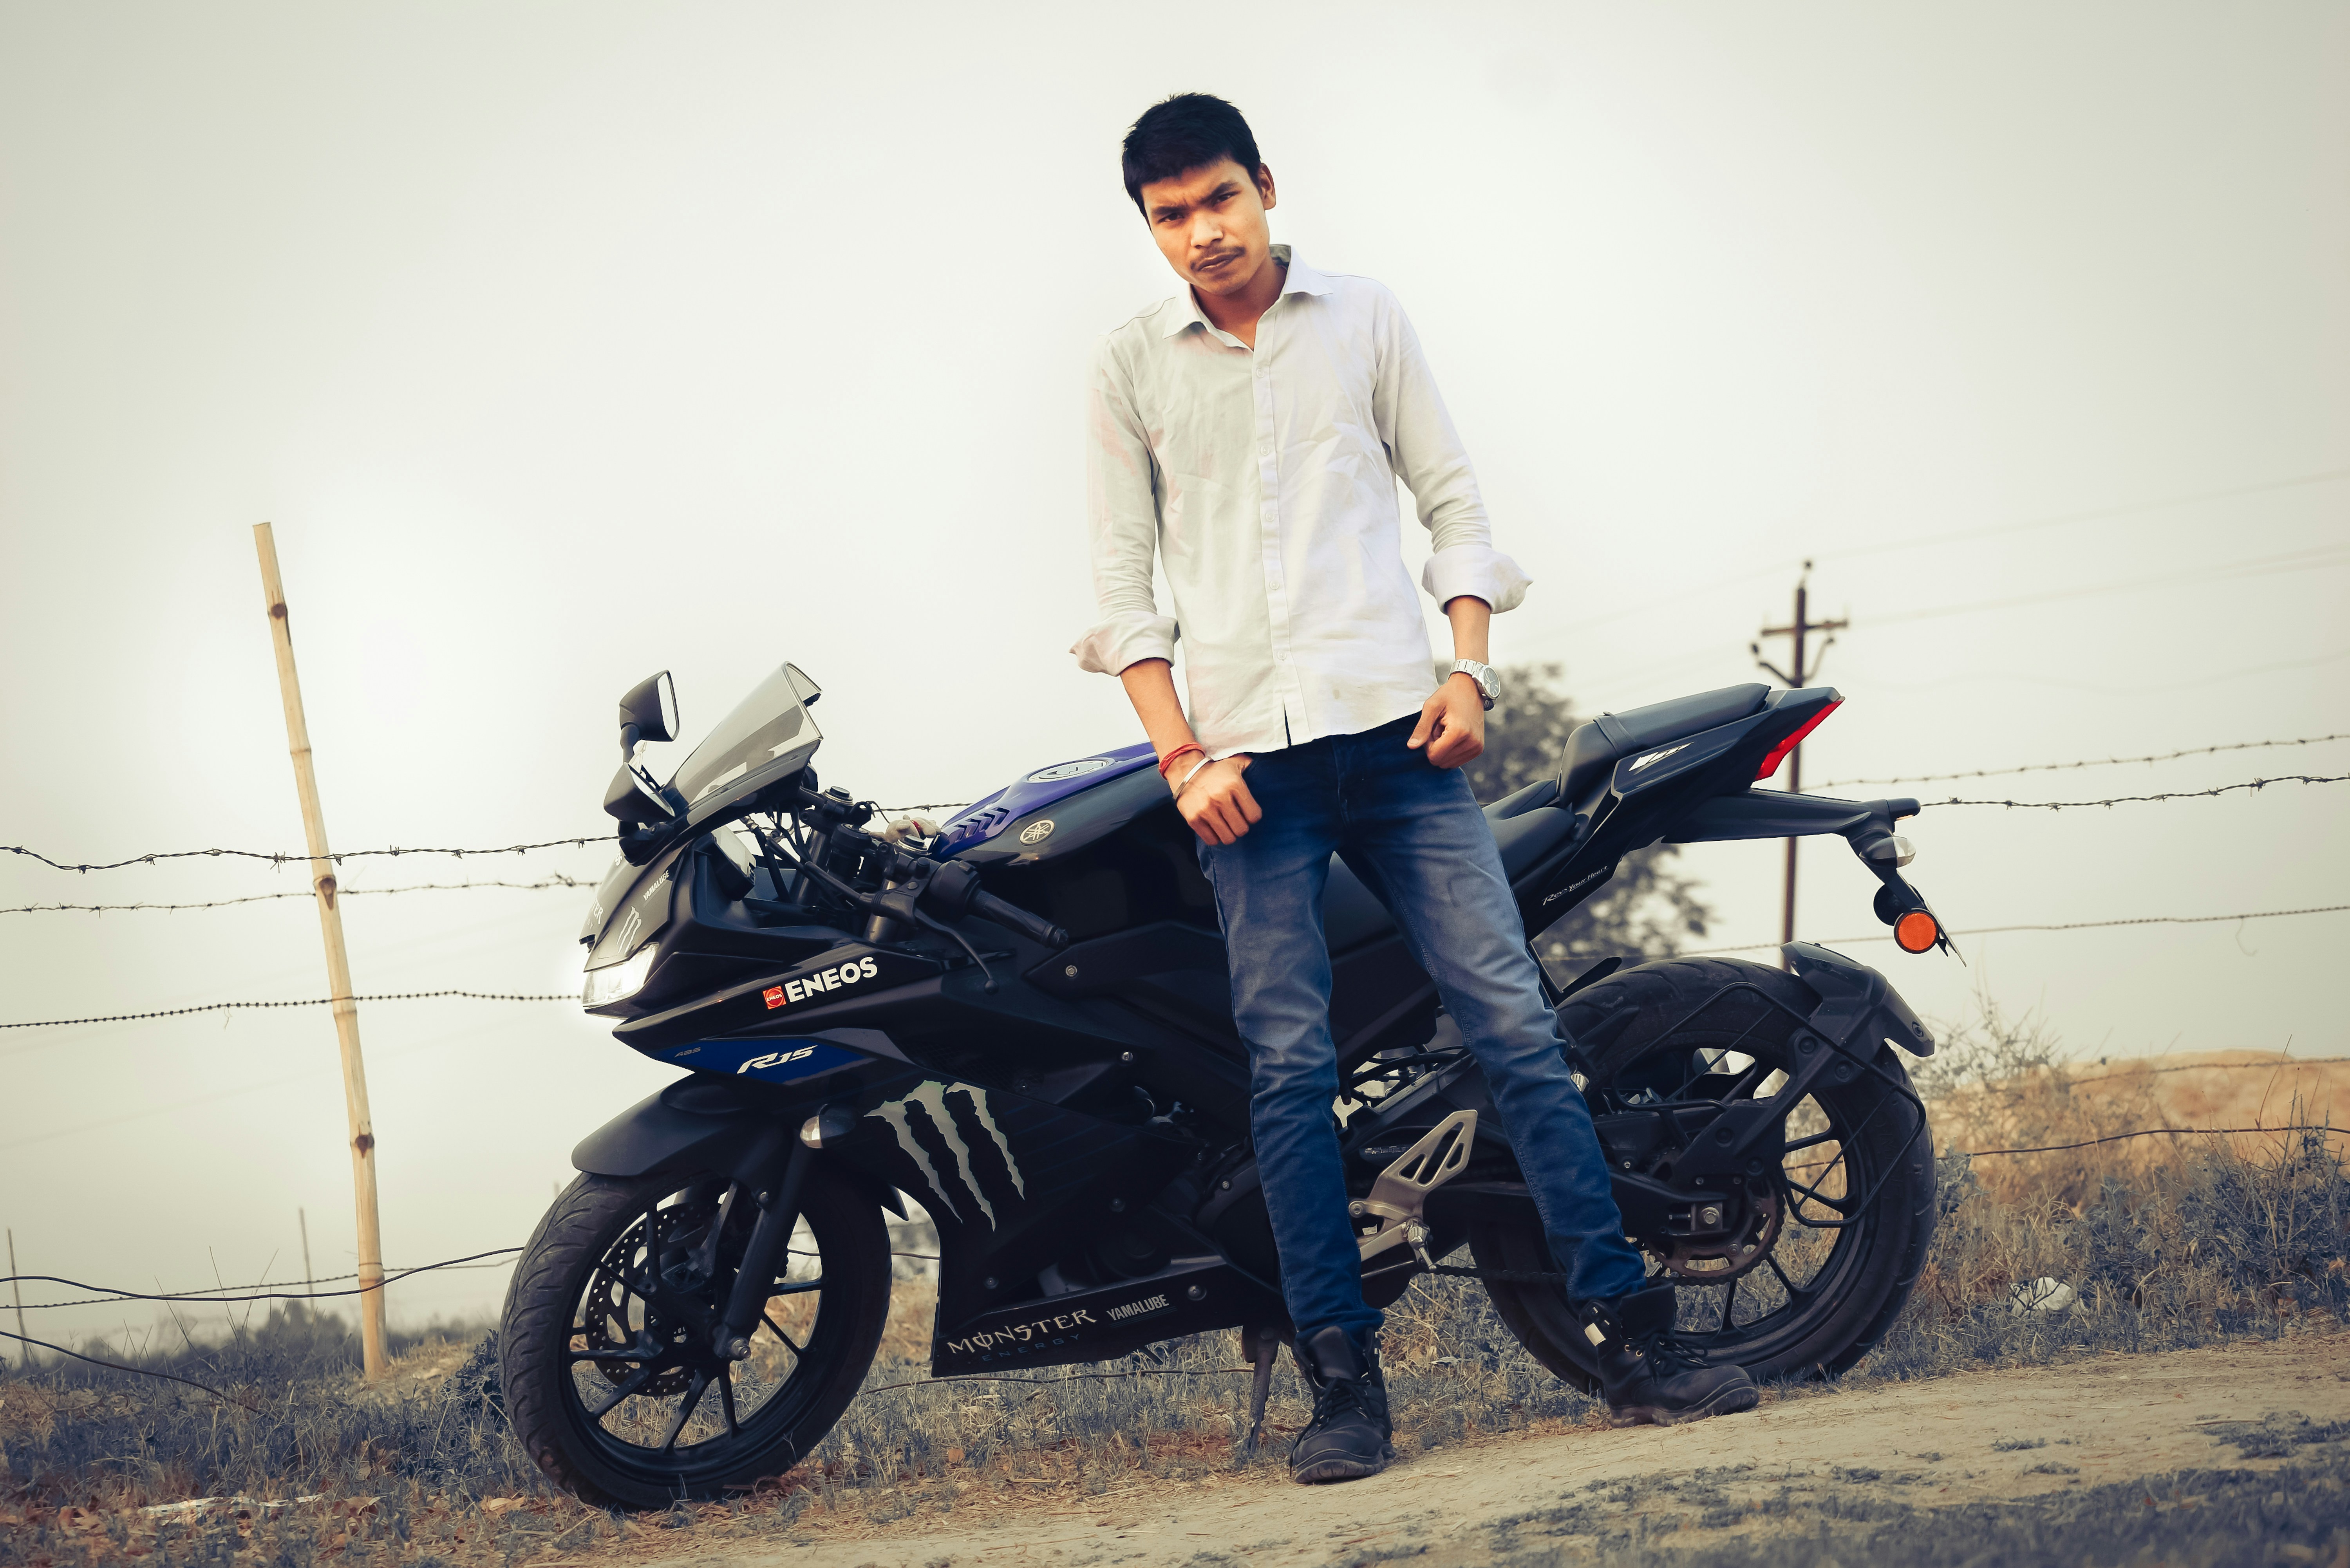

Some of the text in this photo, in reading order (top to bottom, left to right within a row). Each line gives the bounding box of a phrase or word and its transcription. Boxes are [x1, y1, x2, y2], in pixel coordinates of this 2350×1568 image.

[642, 869, 670, 901] YAMALUBE
[1569, 877, 1587, 892] Your
[1587, 865, 1607, 880] Heart
[785, 956, 878, 1003] ENEOS
[766, 993, 783, 1002] ENEOS
[674, 1046, 701, 1058] ABS
[736, 1044, 818, 1074] R15
[1106, 1294, 1170, 1321] YAMALUBE
[947, 1309, 1097, 1355] MONSTER
[982, 1333, 1079, 1362] ENERGY
